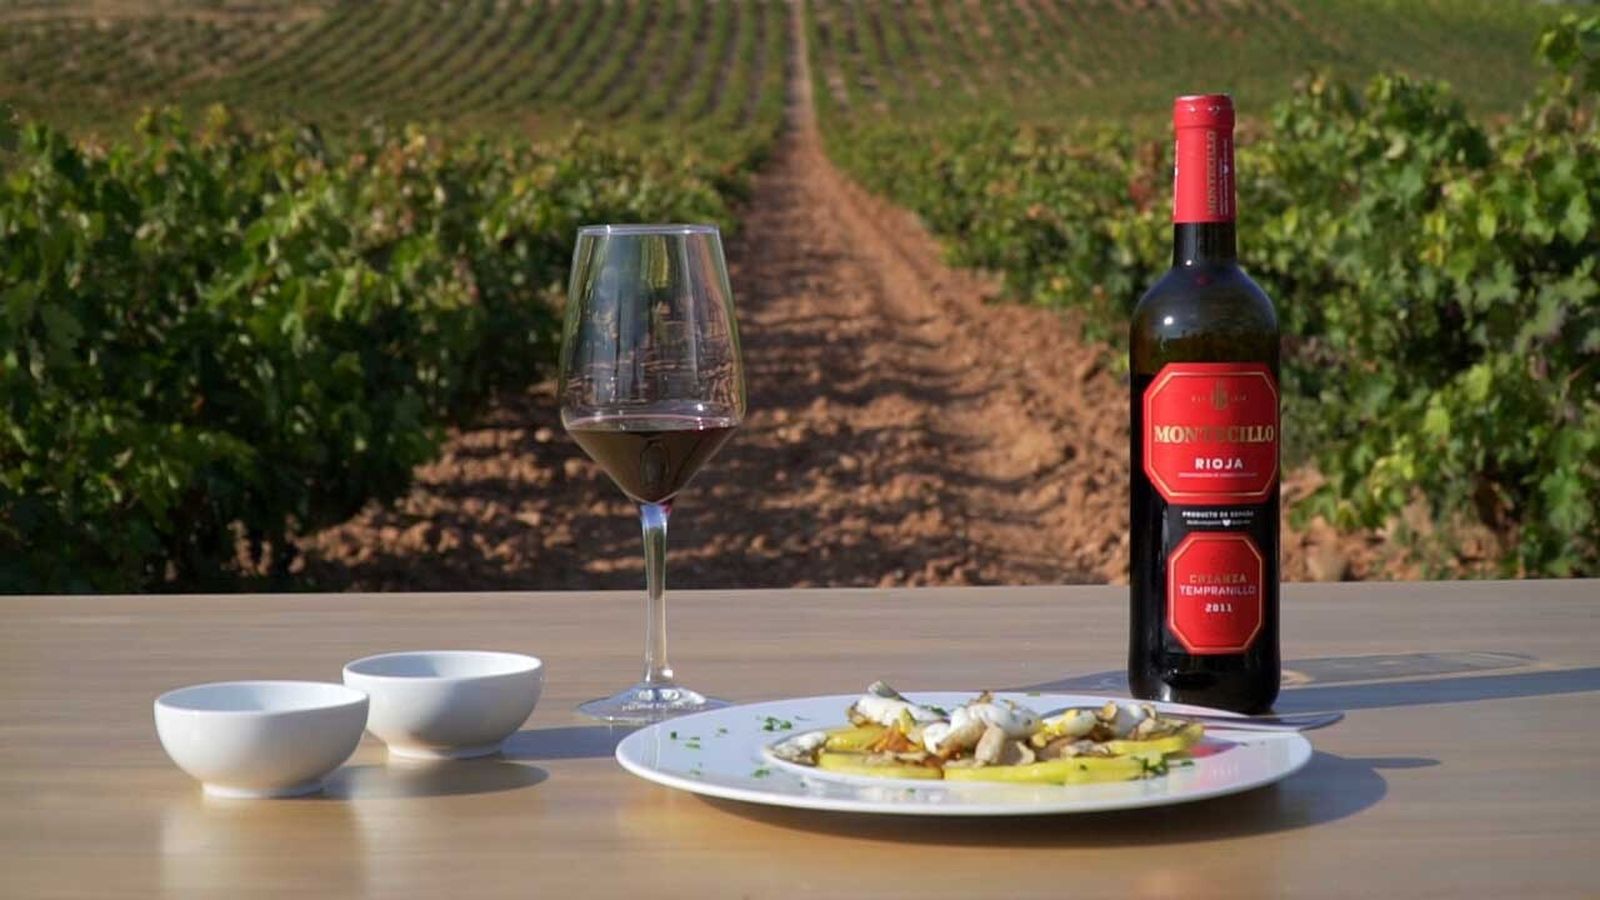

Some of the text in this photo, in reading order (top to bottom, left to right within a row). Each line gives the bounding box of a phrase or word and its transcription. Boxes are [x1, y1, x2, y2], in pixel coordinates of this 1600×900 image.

[1154, 425, 1274, 443] MONTECILLO
[1195, 458, 1243, 470] RIOJA
[1189, 574, 1247, 583] CRIANZA
[1179, 585, 1257, 596] TEMPRANILLO
[1205, 603, 1233, 613] 2011
